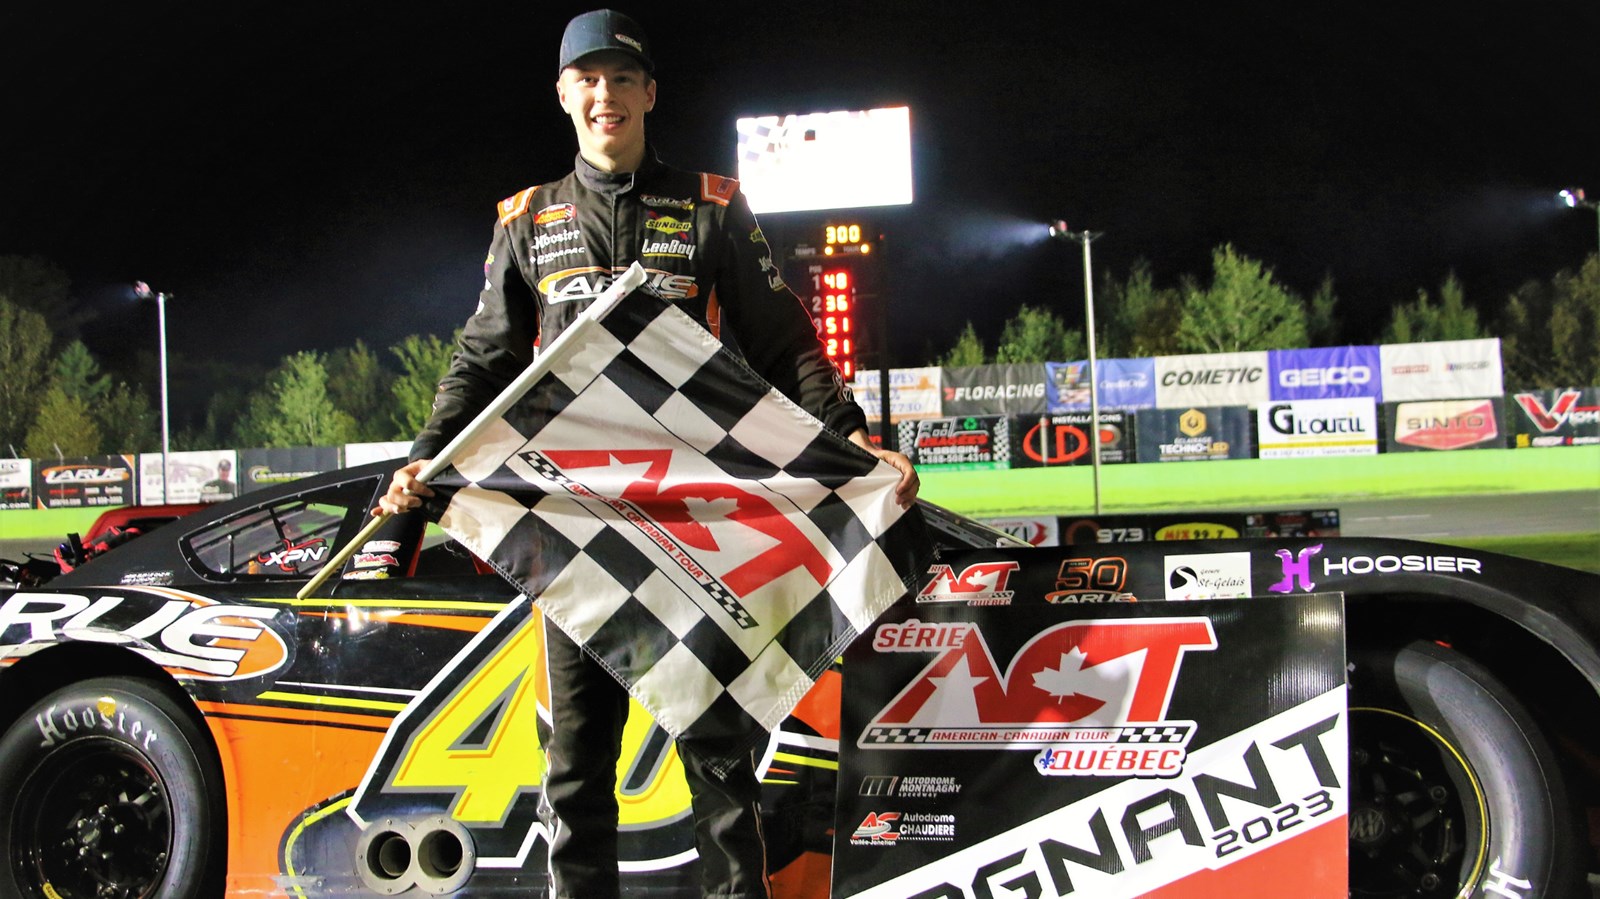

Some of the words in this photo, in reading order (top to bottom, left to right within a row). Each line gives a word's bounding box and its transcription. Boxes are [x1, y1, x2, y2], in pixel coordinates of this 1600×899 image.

[648, 221, 690, 230] SUNOCO
[826, 225, 860, 244] 300
[531, 229, 580, 249] Hoosier
[536, 247, 585, 264] DYNAPAC
[642, 239, 696, 260] LeeBoy
[812, 275, 820, 290] 1
[812, 296, 822, 312] 2
[826, 294, 848, 312] 36
[826, 317, 849, 335] 51
[827, 339, 850, 356] 21
[867, 373, 914, 384] POPES
[1161, 367, 1263, 387] COMETIC
[1279, 365, 1371, 388] GEICO
[954, 384, 1046, 402] FLORACING
[1052, 414, 1122, 424] INSTALLAONS
[1268, 403, 1295, 435] G
[1407, 415, 1484, 430] SINTO
[1159, 441, 1229, 454] TECHNO-LED
[45, 467, 127, 484] LARUE
[1164, 530, 1190, 541] MIX
[626, 511, 676, 552] CANADIAN
[674, 551, 704, 581] TOUR
[266, 547, 323, 566] XPN
[1323, 555, 1482, 576] HOOSIER
[1056, 557, 1127, 591] 50
[1198, 577, 1245, 589] St-Gelais
[877, 623, 966, 648] SÉRIE
[876, 621, 1213, 724] ACT
[36, 701, 158, 749] Hoosier
[1073, 730, 1109, 741] TOUR
[1050, 746, 1180, 770] QUÉBEC
[900, 784, 961, 793] MONTMAGNY
[903, 813, 955, 823] Autodrome
[1210, 789, 1336, 858] 2023
